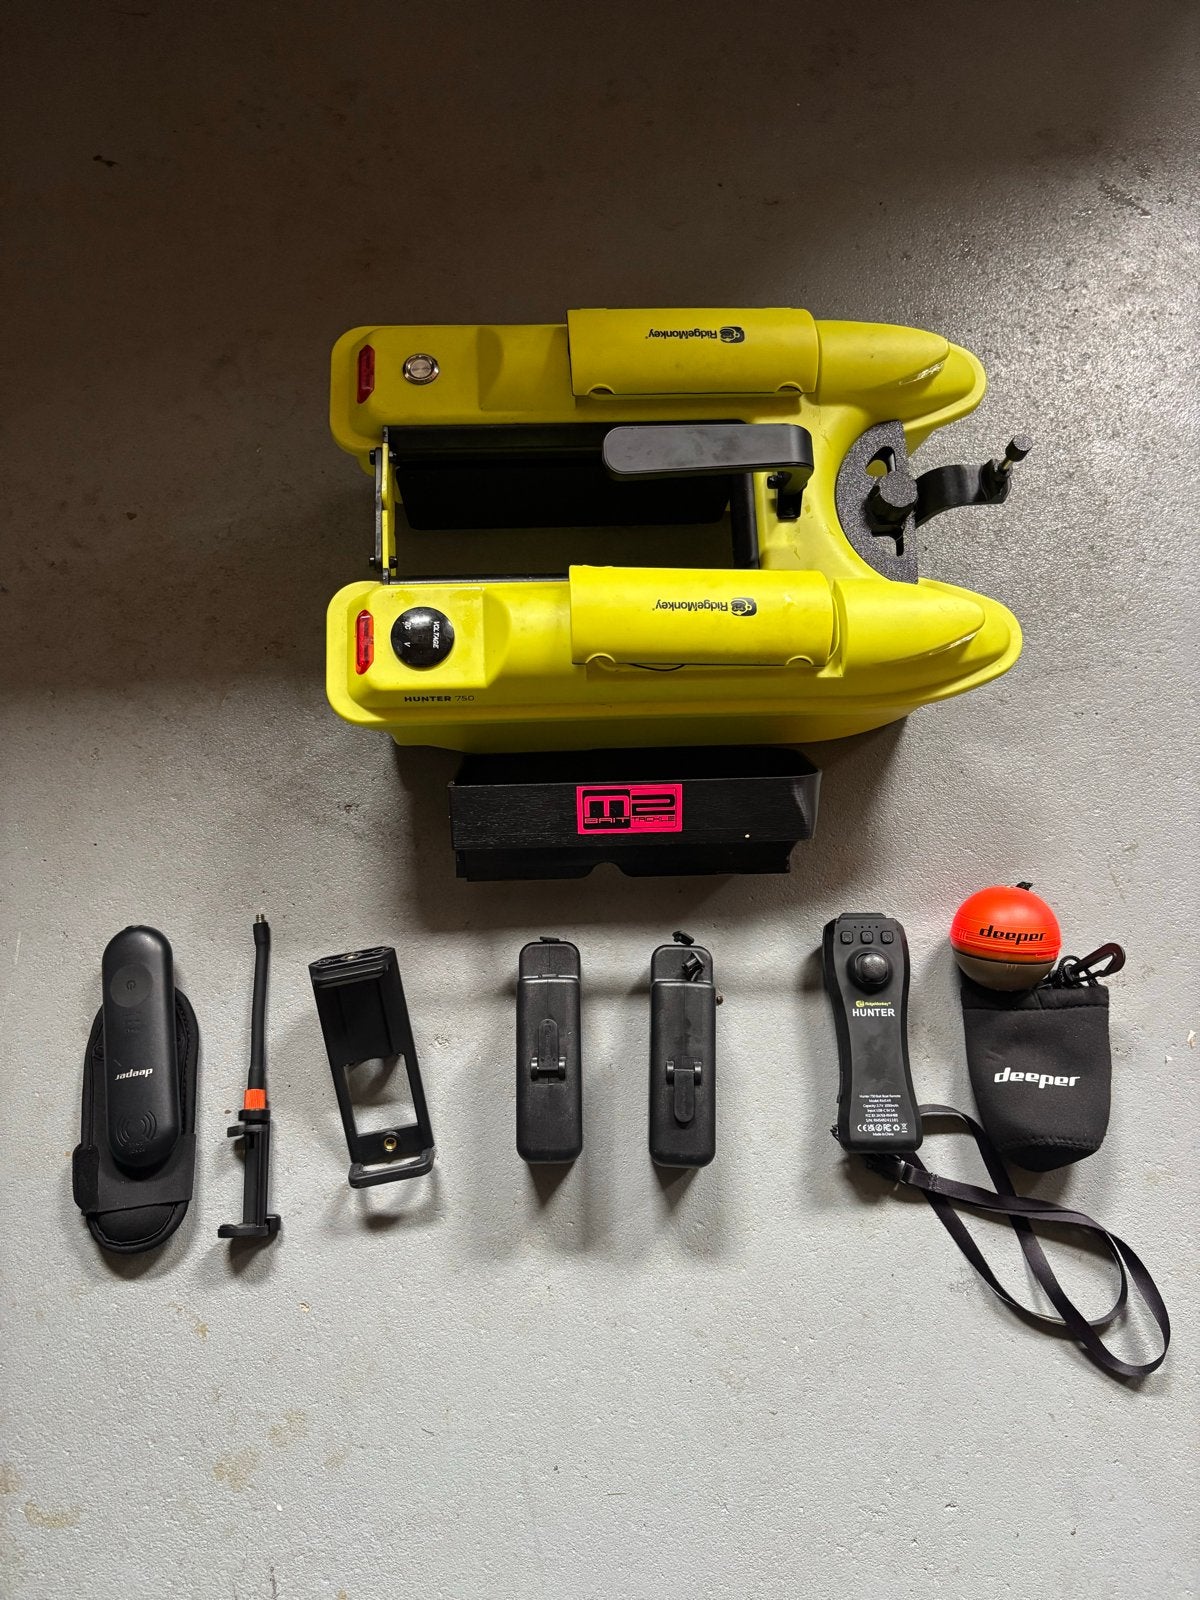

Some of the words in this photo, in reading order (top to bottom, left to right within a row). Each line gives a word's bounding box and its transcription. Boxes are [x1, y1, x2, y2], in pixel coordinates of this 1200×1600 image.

[648, 328, 718, 339] RidgeMonkey
[655, 599, 728, 611] RidgeMonkey
[432, 621, 440, 649] VOLTAGE
[584, 816, 630, 824] BAIT
[979, 925, 1047, 945] deeper
[852, 1008, 895, 1017] HUNTER
[114, 1067, 154, 1081] deeper
[993, 1067, 1080, 1089] deeper
